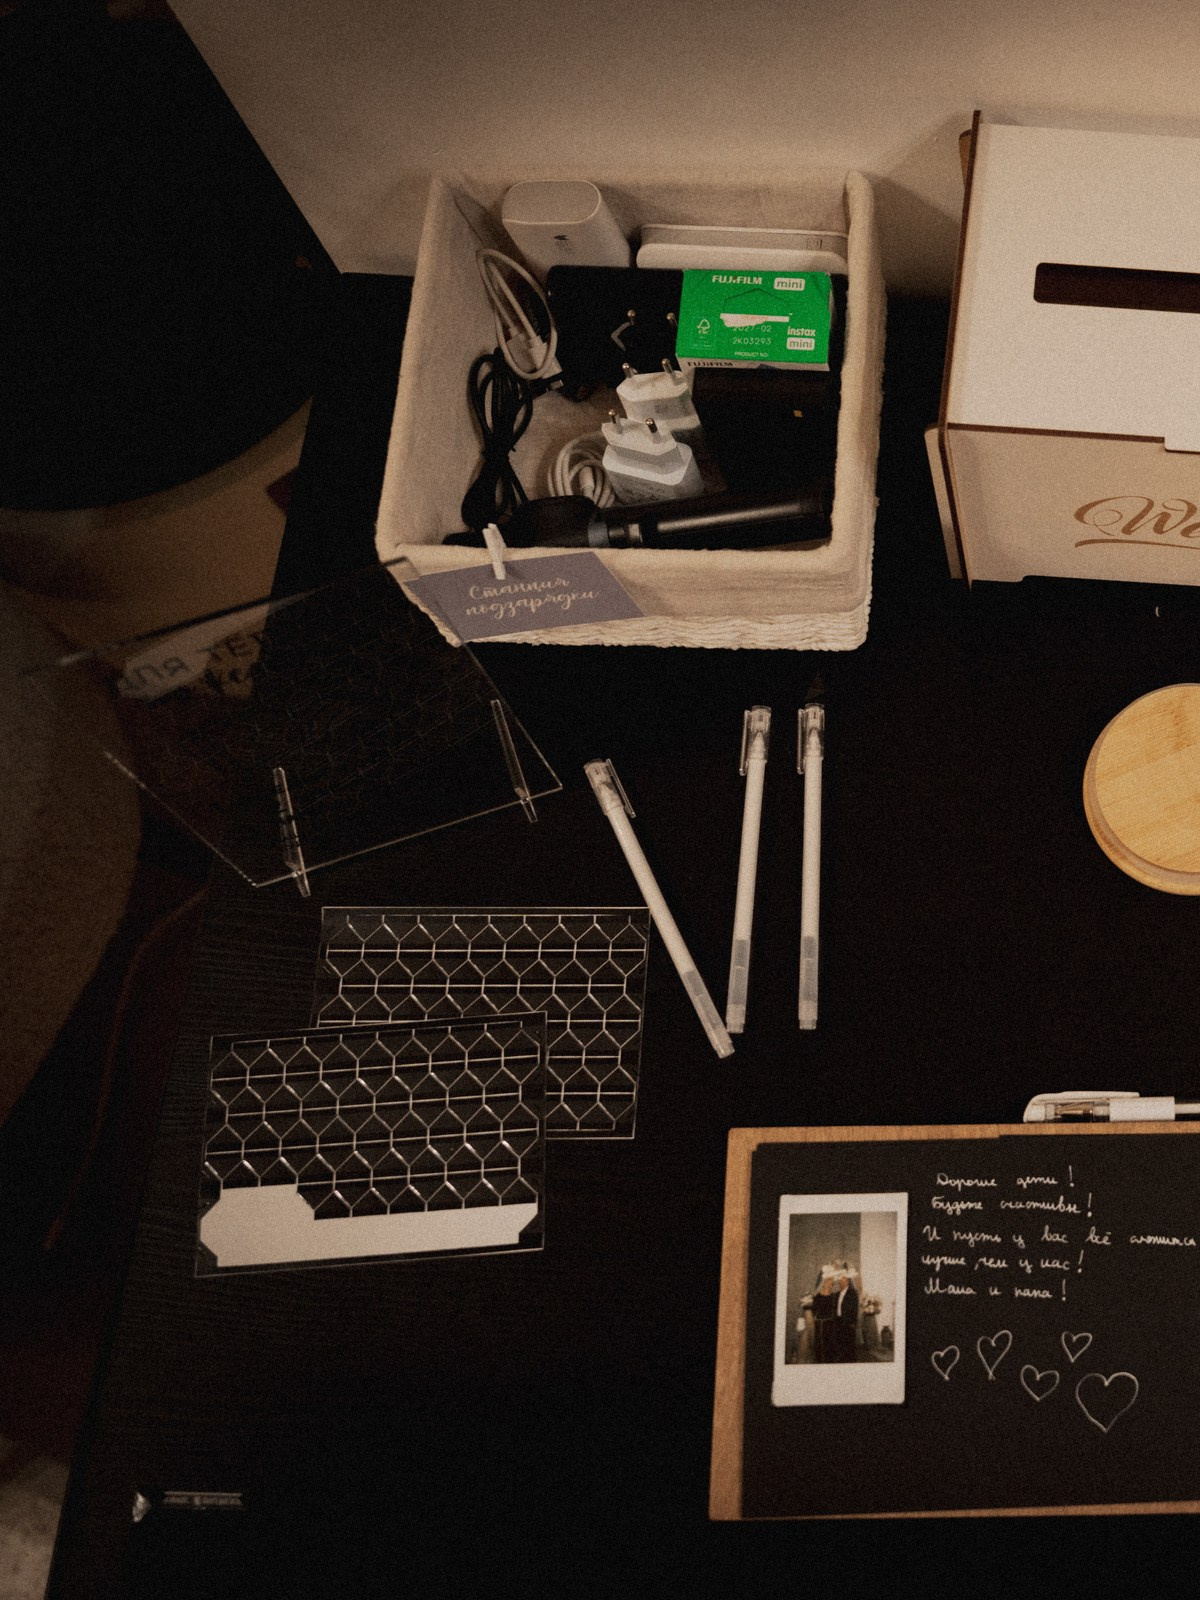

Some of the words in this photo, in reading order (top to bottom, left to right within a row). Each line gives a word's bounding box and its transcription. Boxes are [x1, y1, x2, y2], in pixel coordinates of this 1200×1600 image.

[711, 275, 763, 285] FUJIFILM
[776, 280, 803, 289] mini
[787, 326, 816, 337] instax
[732, 337, 772, 346] 2K03293
[789, 341, 813, 349] mini
[469, 577, 571, 600] Станция
[466, 591, 599, 619] подзарядки
[936, 1172, 998, 1192] Дорогие
[931, 1195, 983, 1216] Будьте
[922, 1225, 942, 1242] И
[953, 1230, 1002, 1248] пусть
[1012, 1234, 1026, 1249] у
[1041, 1225, 1069, 1243] вас
[1085, 1226, 1112, 1246] всё
[1019, 1259, 1033, 1274] у
[989, 1286, 1002, 1297] и
